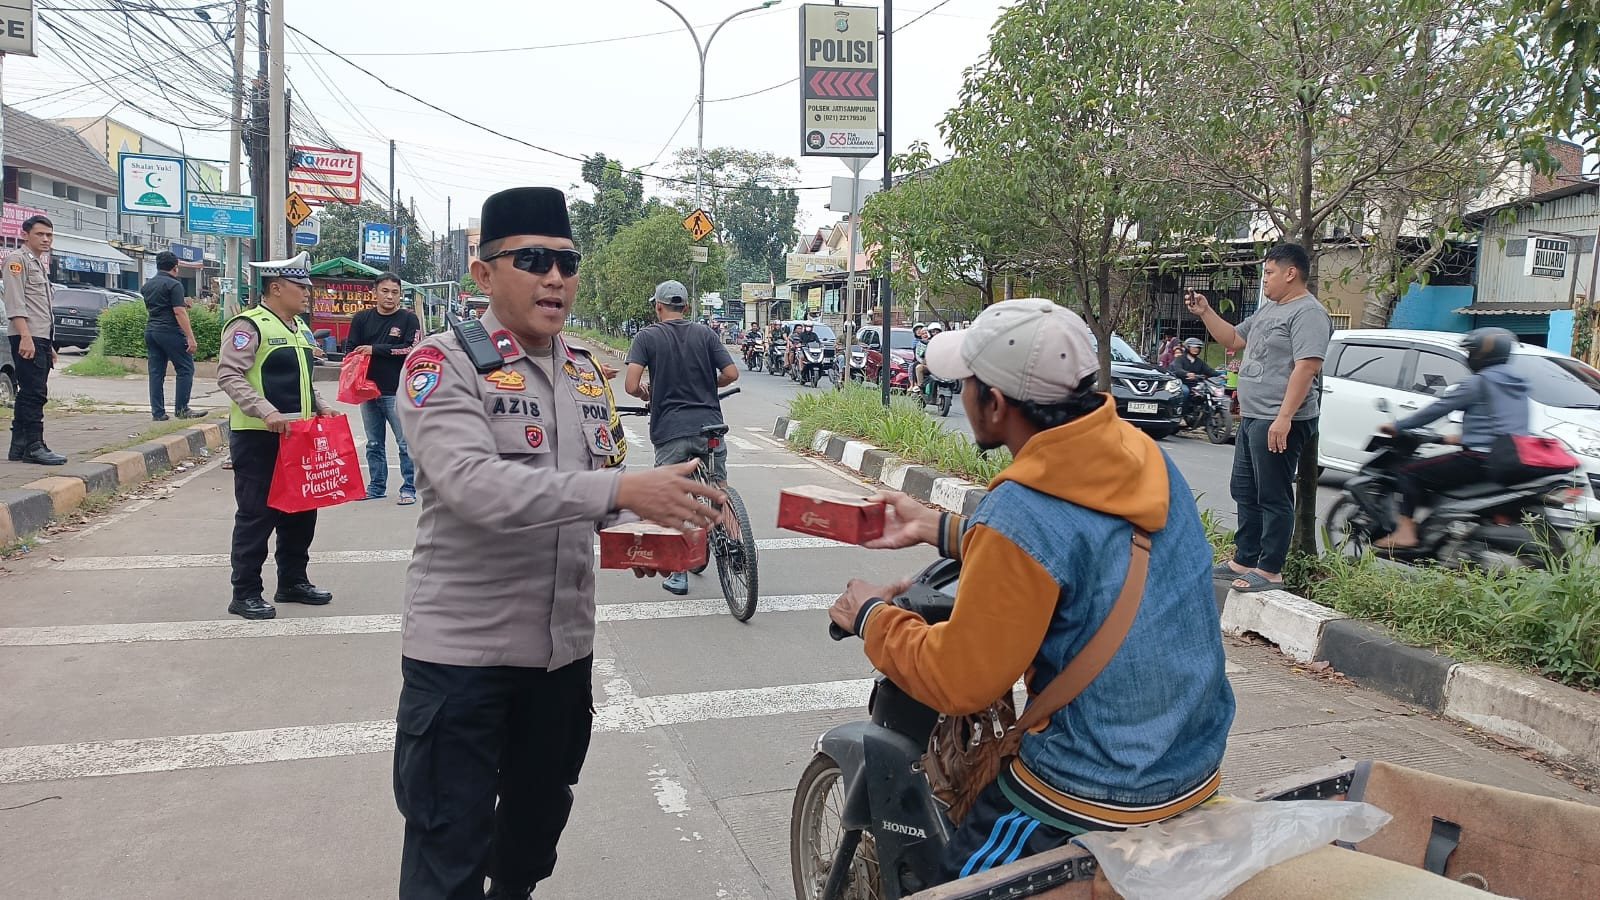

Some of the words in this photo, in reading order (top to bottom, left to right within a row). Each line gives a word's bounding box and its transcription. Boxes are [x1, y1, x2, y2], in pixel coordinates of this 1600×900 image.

[809, 38, 873, 63] POLISI
[808, 104, 830, 112] POLSEK
[832, 105, 876, 113] JATISAMPURNA
[1535, 250, 1564, 268] BILLIARD
[326, 283, 369, 291] MADURA
[313, 289, 343, 300] NASI
[313, 303, 340, 312] AYAM
[493, 396, 540, 417] AZIS
[315, 460, 335, 471] TANPA
[305, 467, 340, 481] Kantong
[302, 477, 340, 497] Plastik
[882, 820, 928, 839] HONDA
